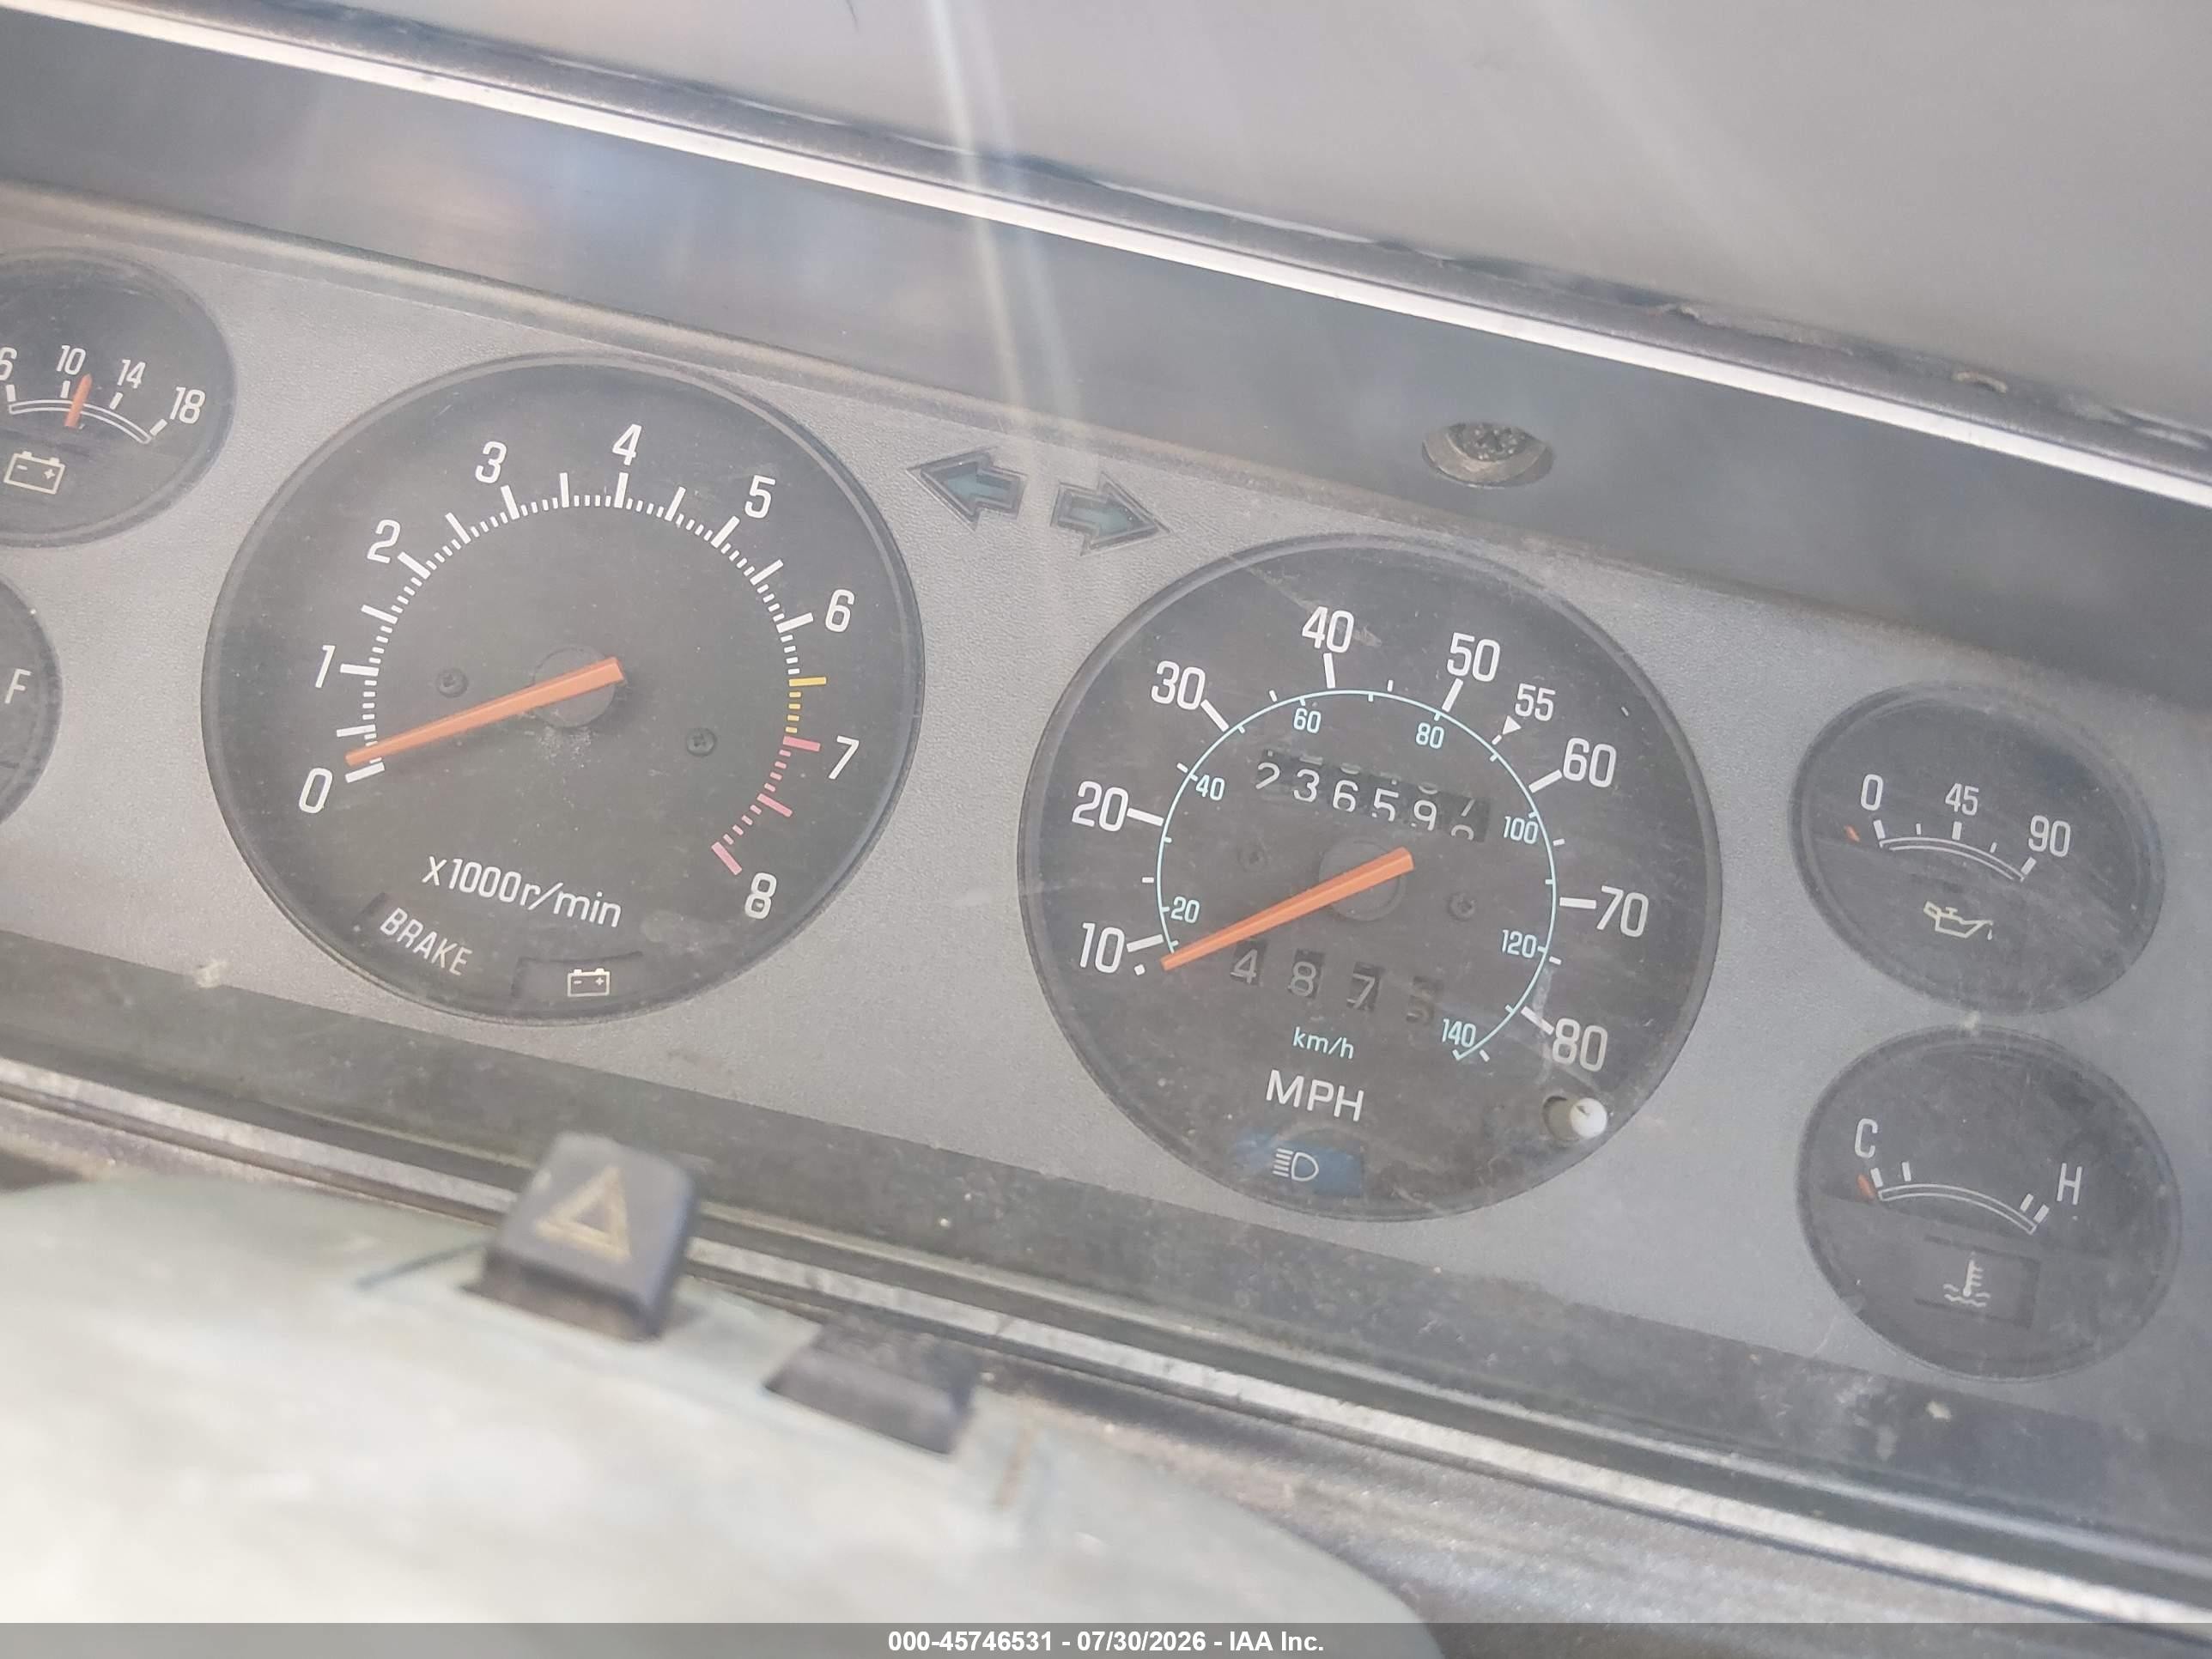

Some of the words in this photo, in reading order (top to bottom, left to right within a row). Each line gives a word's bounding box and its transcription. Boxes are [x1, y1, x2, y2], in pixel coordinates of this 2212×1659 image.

[56, 345, 86, 375] 10
[117, 359, 146, 389] 14
[169, 386, 206, 424] 18
[475, 441, 507, 483] 3
[612, 424, 642, 465] 4
[744, 475, 776, 519] 5
[367, 520, 401, 563] 2
[825, 589, 855, 633] 6
[1302, 606, 1354, 653] 40
[315, 645, 336, 688] 1
[1447, 632, 1500, 682] 50
[4, 668, 32, 704] F
[1152, 660, 1206, 710] 30
[1515, 684, 1556, 721] 55
[1293, 708, 1322, 733] 60
[1416, 722, 1444, 749] 80
[828, 735, 860, 780] 7
[1563, 738, 1617, 787] 60
[299, 768, 333, 814] 0
[1072, 781, 1128, 831] 20
[1195, 775, 1225, 801] 40
[1861, 774, 1883, 811] 0
[1945, 782, 1979, 815] 45
[1504, 816, 1538, 844] 100
[2028, 815, 2070, 857] 90
[744, 872, 777, 920] 8
[1170, 896, 1200, 924] 20
[1596, 885, 1649, 937] 70
[380, 907, 473, 975] BRAKE
[1079, 922, 1125, 973] 10
[1502, 929, 1537, 958] 120
[1292, 1026, 1354, 1059] km/h
[1442, 1018, 1476, 1048] 140
[1552, 1018, 1607, 1072] 80
[1266, 1069, 1364, 1121] MPH
[1855, 1118, 1878, 1158] C
[2057, 1163, 2082, 1205] H
